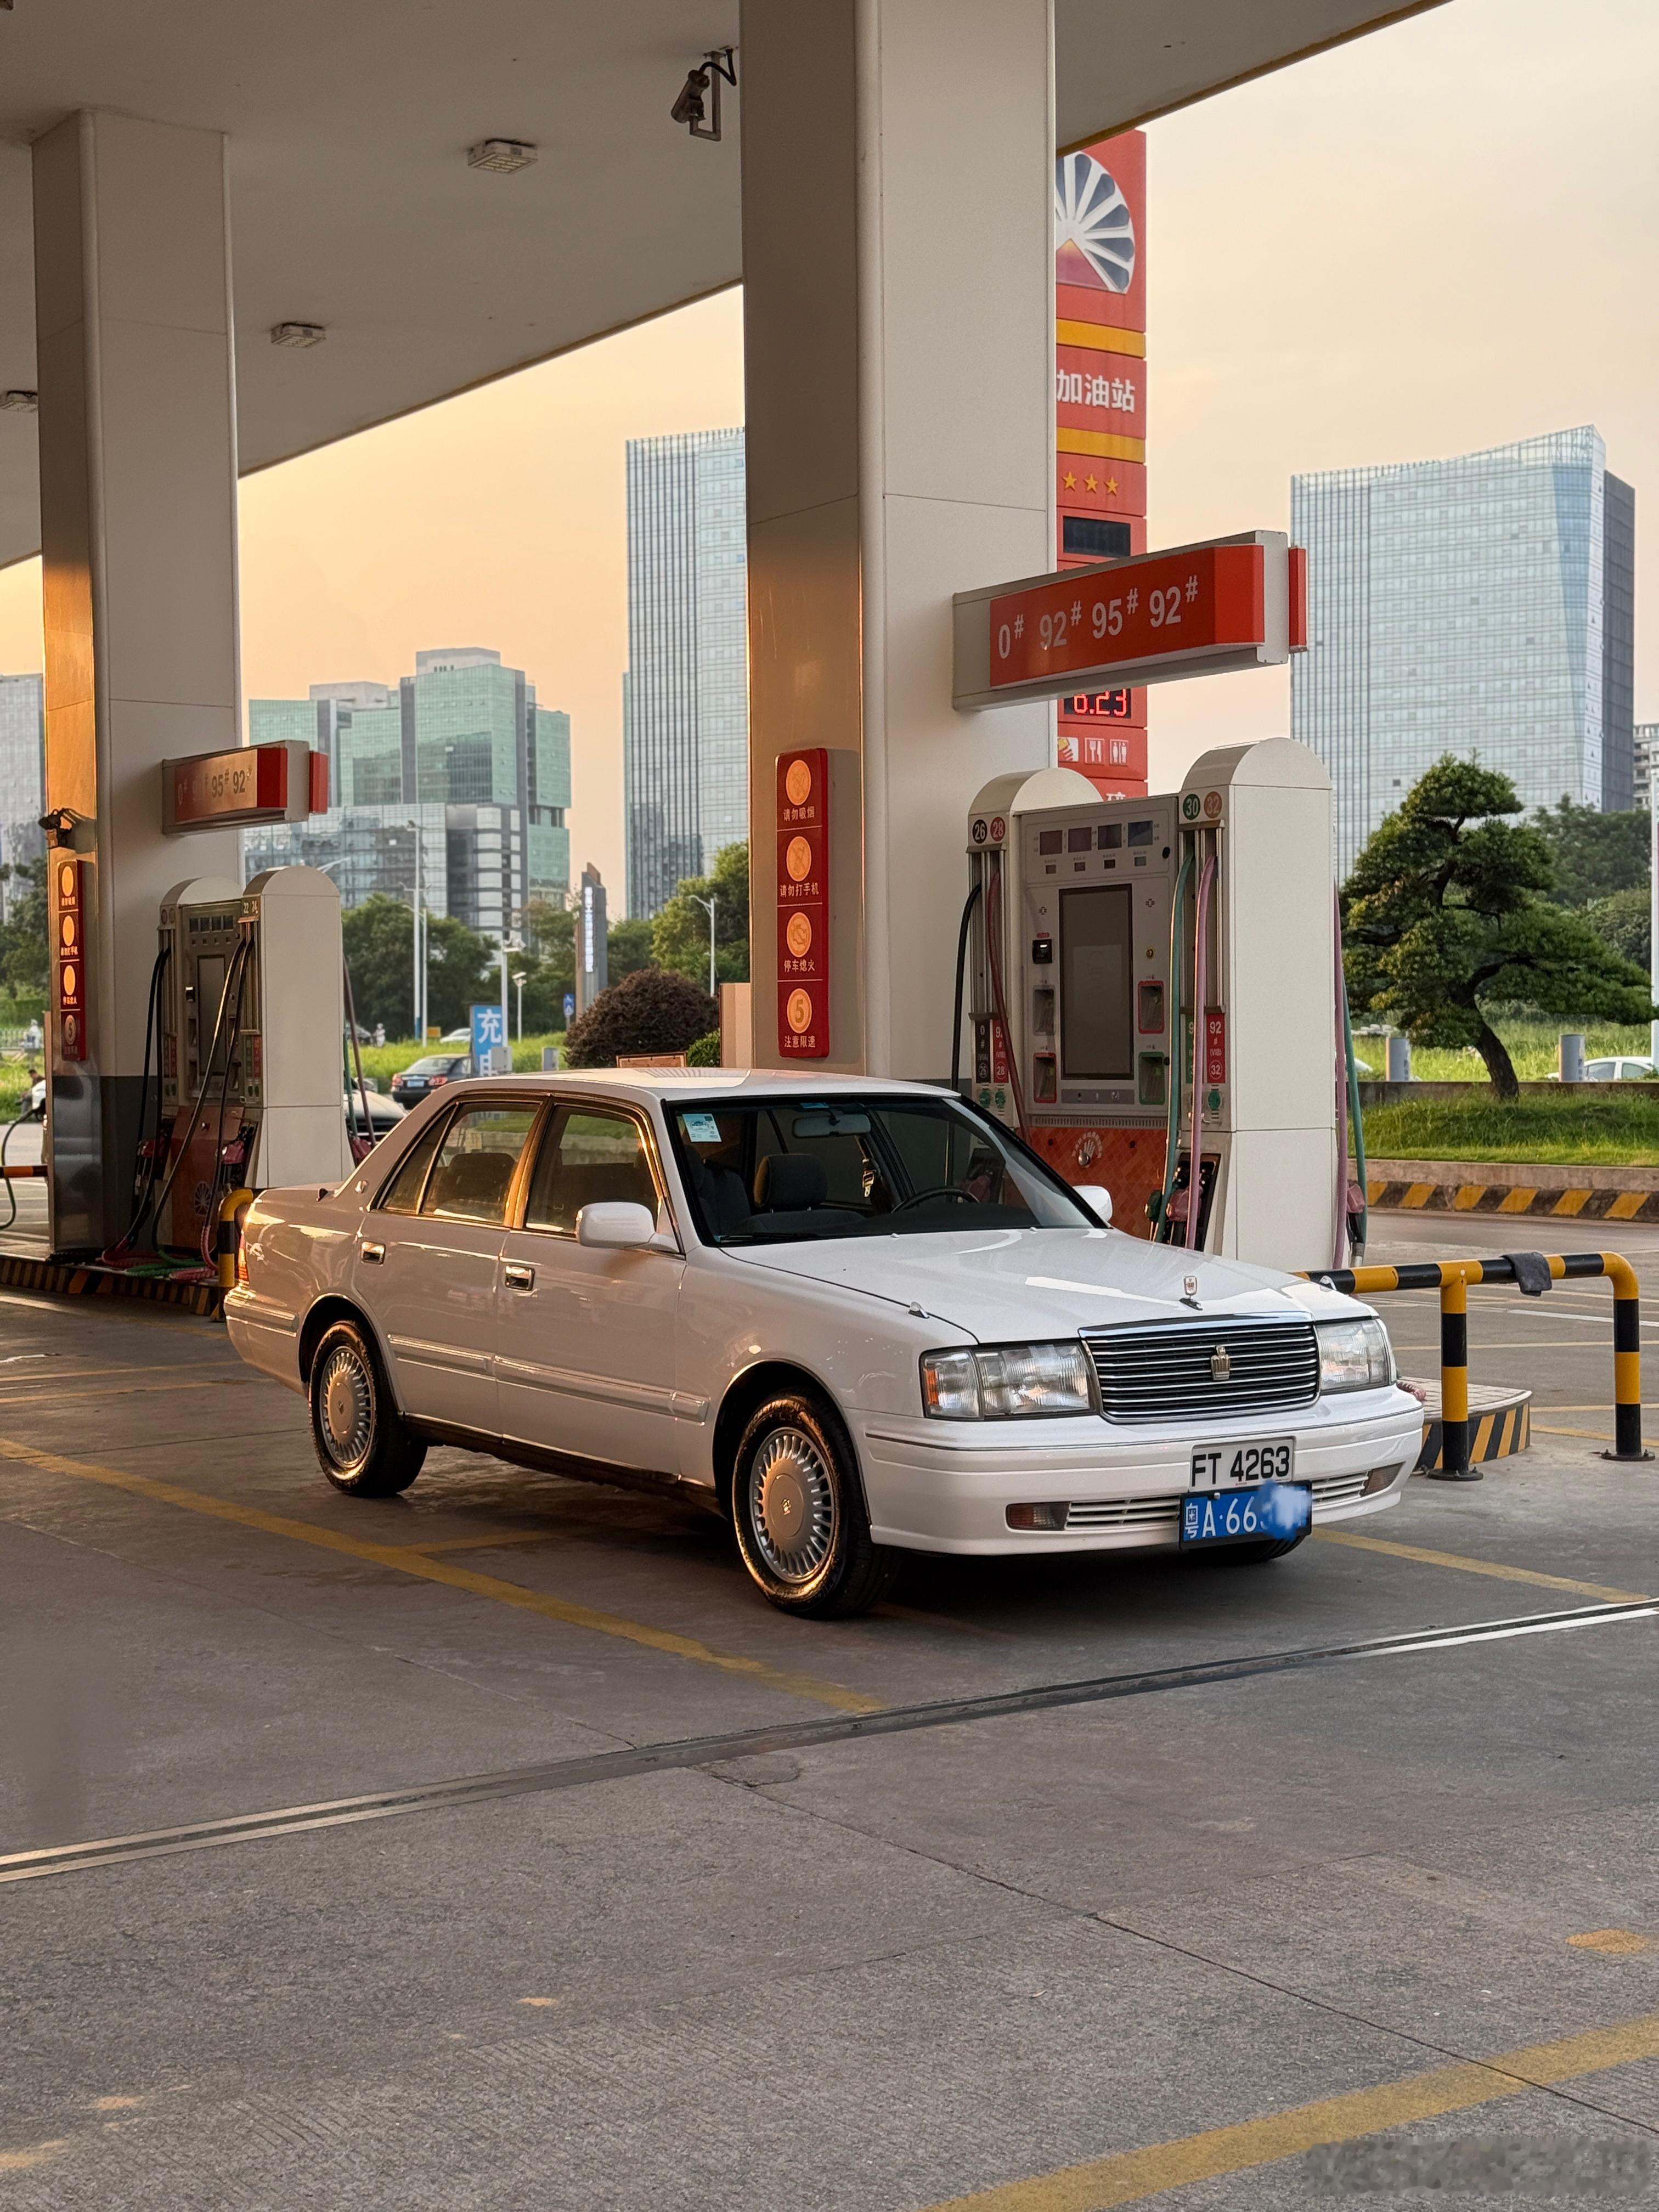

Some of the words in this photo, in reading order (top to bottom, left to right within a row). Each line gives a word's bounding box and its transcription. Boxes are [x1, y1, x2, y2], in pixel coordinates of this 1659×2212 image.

[1057, 369, 1136, 413] 加油站
[998, 614, 1024, 658] 0#
[1040, 601, 1082, 650] 92#
[1092, 588, 1138, 639] 95#
[1149, 575, 1198, 628] 92#
[212, 768, 230, 798] 95#
[1186, 798, 1198, 816] 30
[1208, 795, 1219, 815] 32
[783, 806, 815, 822] 请勿吸烟
[974, 823, 986, 840] 26
[993, 821, 1004, 838] 28
[780, 882, 820, 898] 请勿打手机
[784, 959, 815, 973] 停车熄火
[795, 999, 804, 1024] 5
[980, 1025, 985, 1036] 0
[995, 1026, 1003, 1038] 9
[1209, 1021, 1222, 1034] 92
[784, 1035, 816, 1048] 注意限速
[996, 1066, 1005, 1076] 28
[1211, 1064, 1221, 1075] 32
[1192, 1452, 1222, 1487] FT
[1230, 1446, 1290, 1482] 4263
